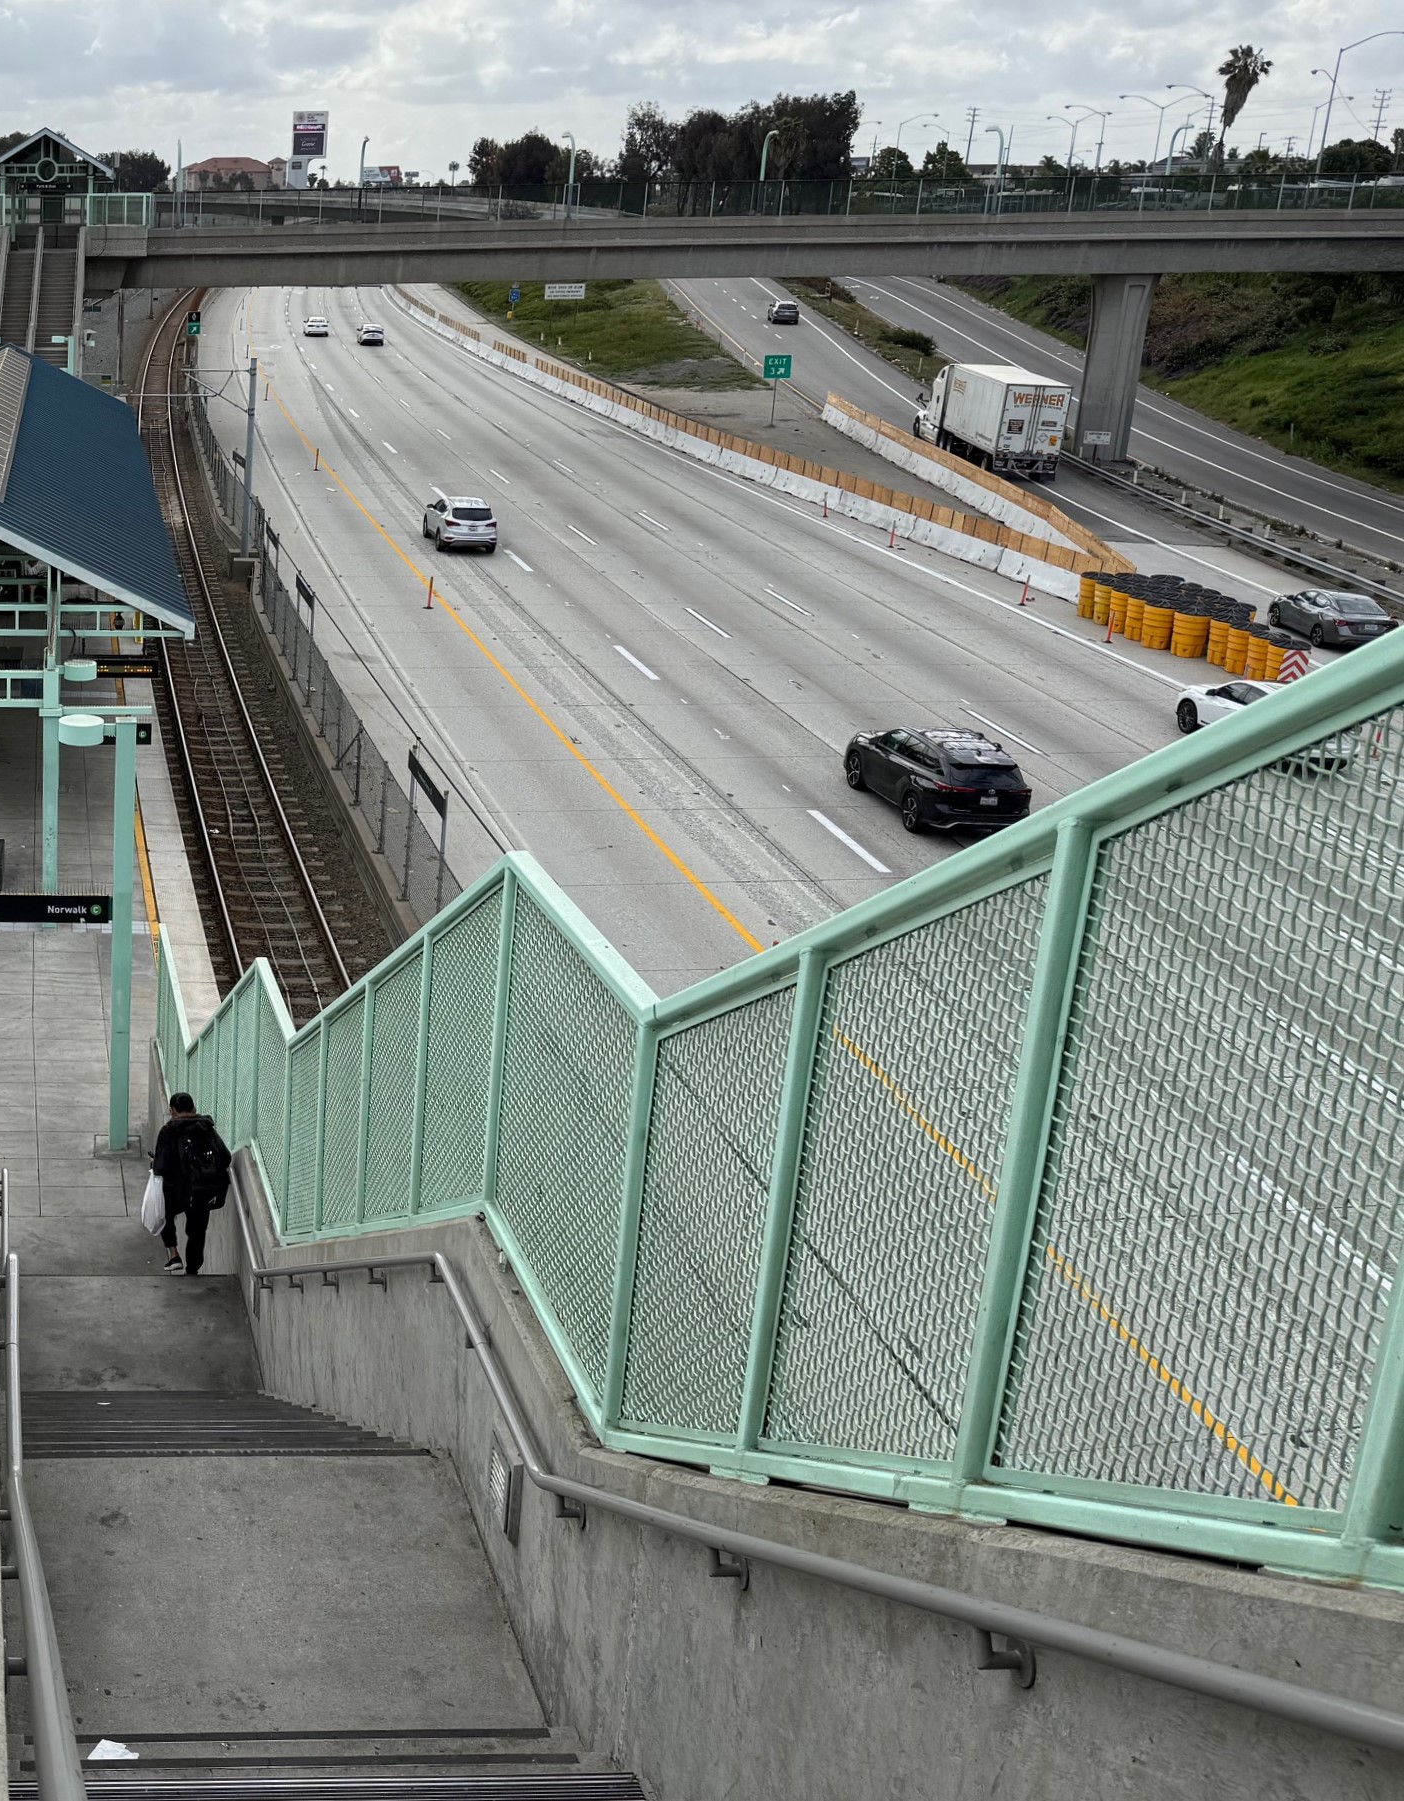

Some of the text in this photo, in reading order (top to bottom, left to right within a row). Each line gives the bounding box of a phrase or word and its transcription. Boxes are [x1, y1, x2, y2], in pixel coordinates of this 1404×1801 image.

[769, 367, 775, 375] 3
[1013, 391, 1065, 408] WERNER
[47, 905, 87, 914] Norwalk
